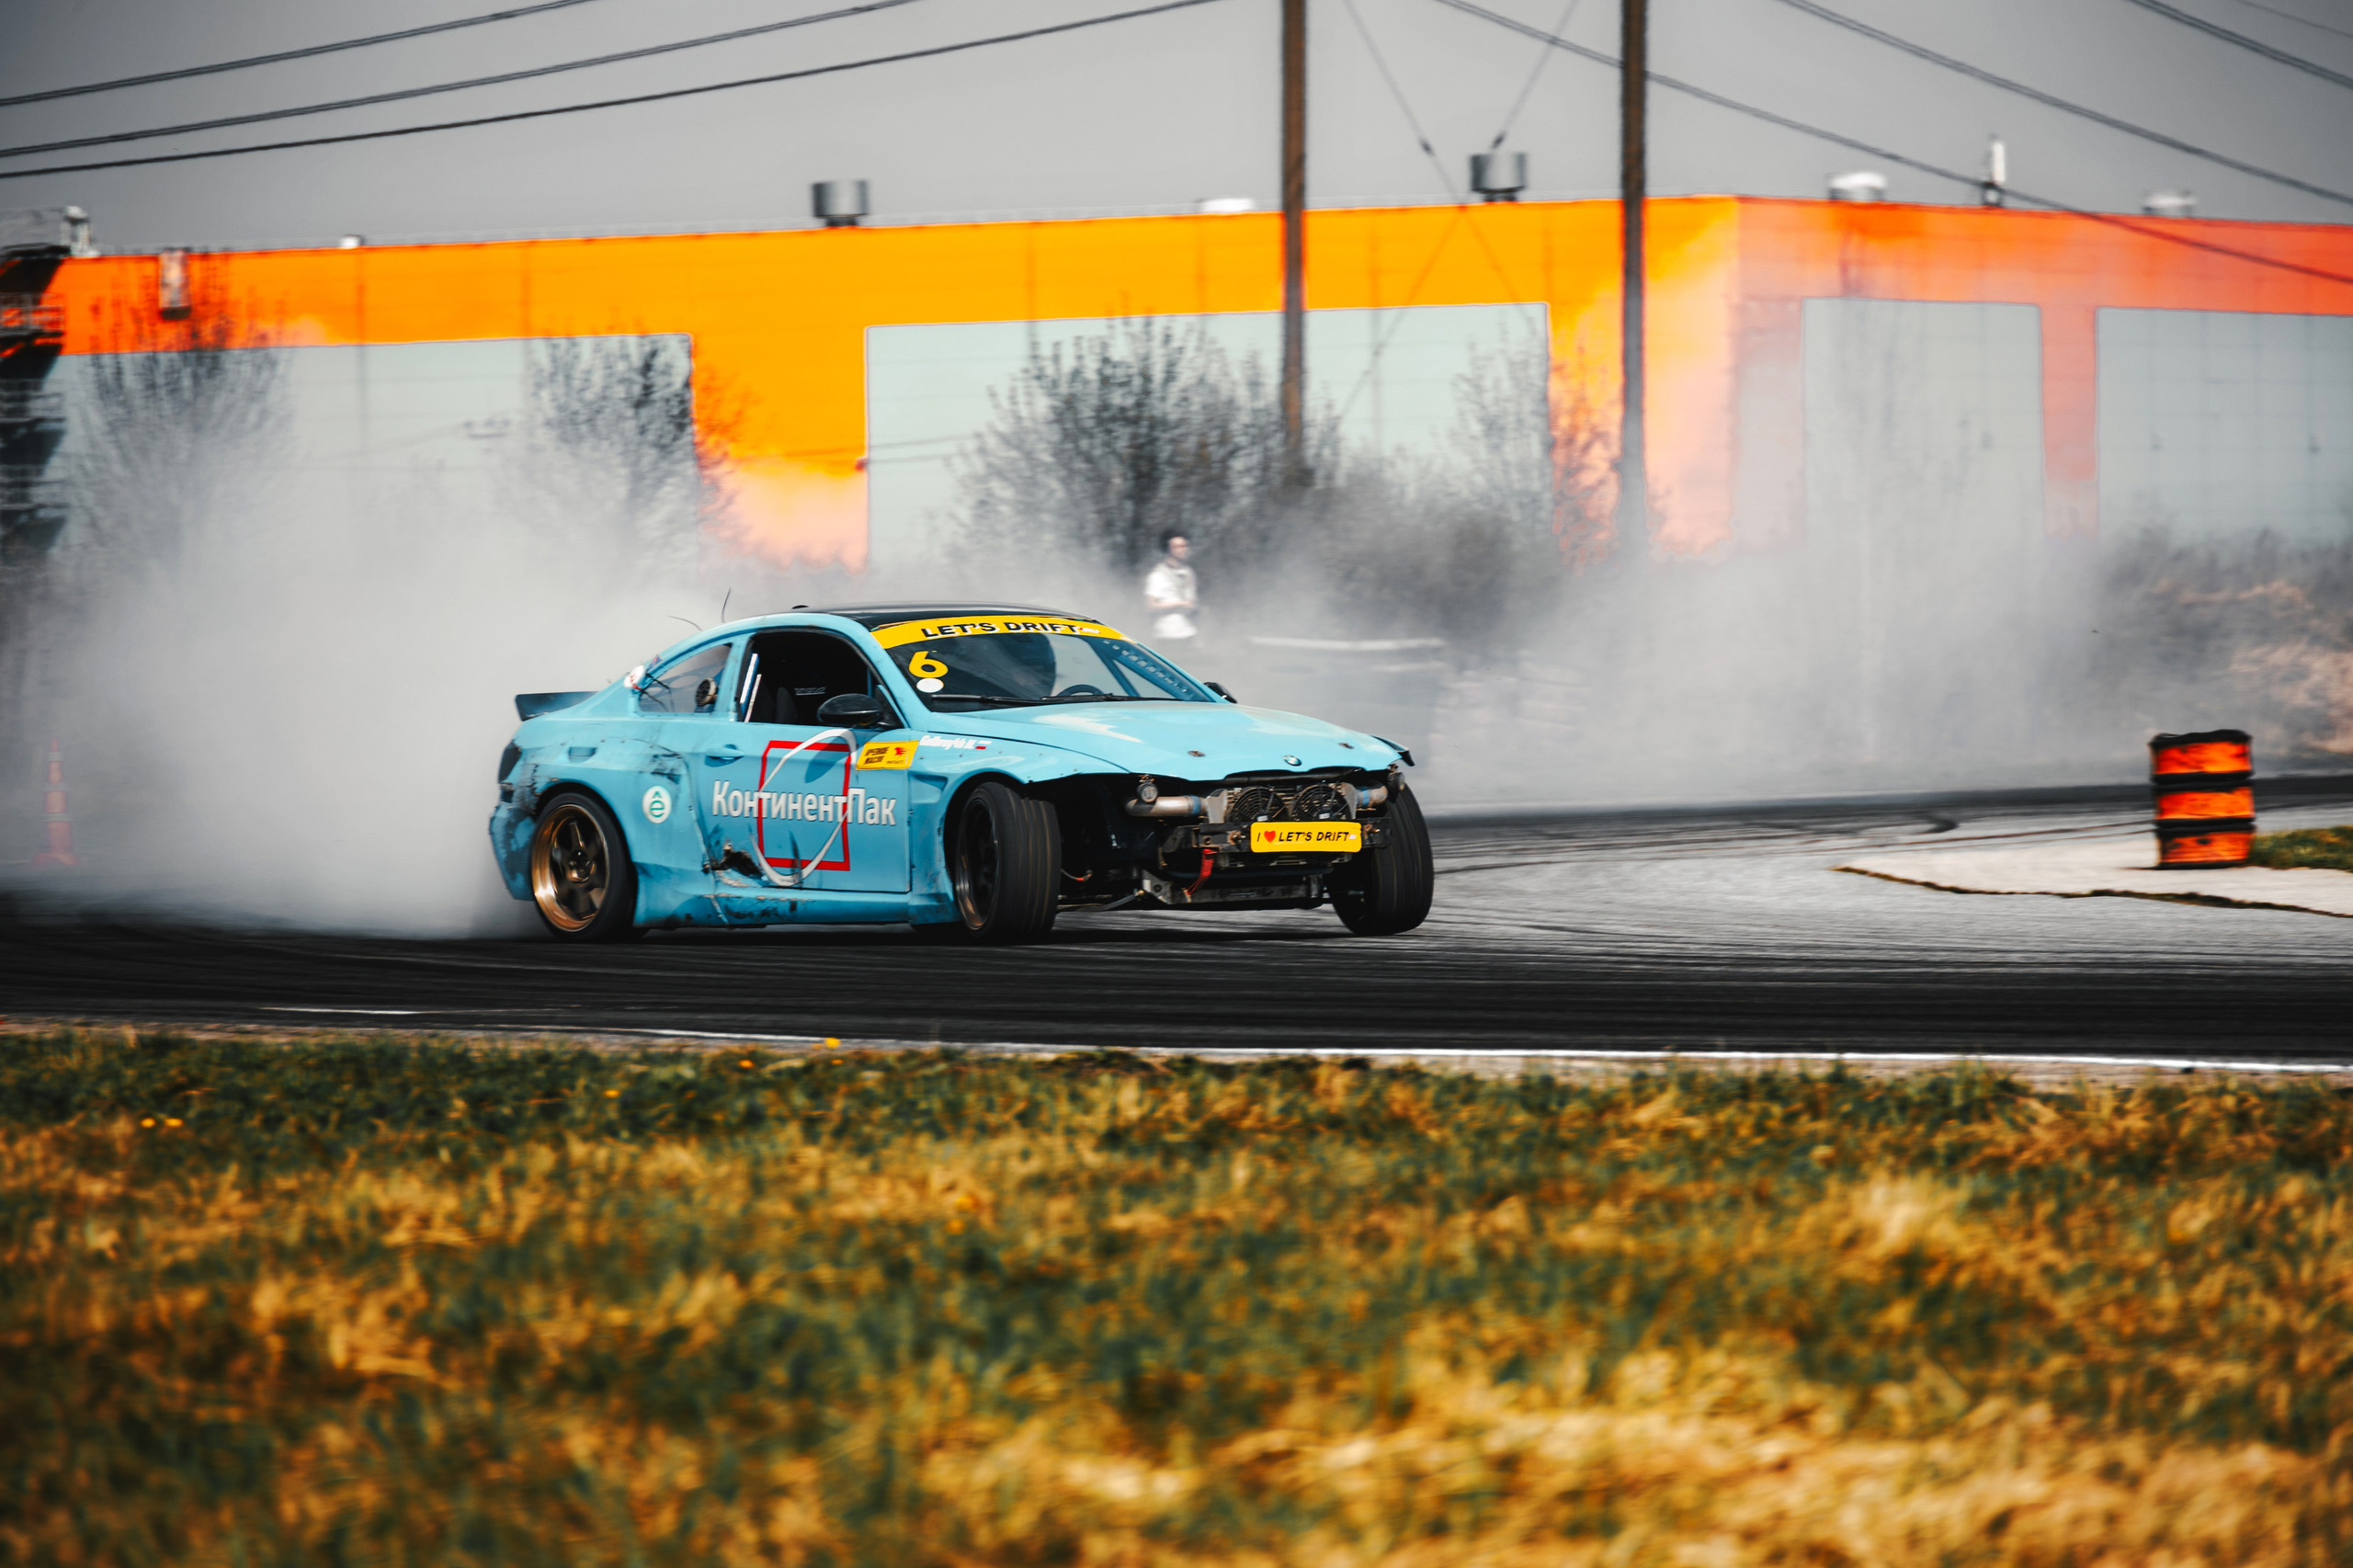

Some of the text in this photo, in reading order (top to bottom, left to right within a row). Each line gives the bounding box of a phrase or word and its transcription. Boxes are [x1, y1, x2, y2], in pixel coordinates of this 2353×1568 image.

[921, 622, 997, 638] LET'S
[1003, 621, 1083, 634] DRIFT
[908, 651, 949, 678] 6
[711, 779, 897, 826] КонтинентПак
[1256, 831, 1350, 842] I LET'S DRIFT
